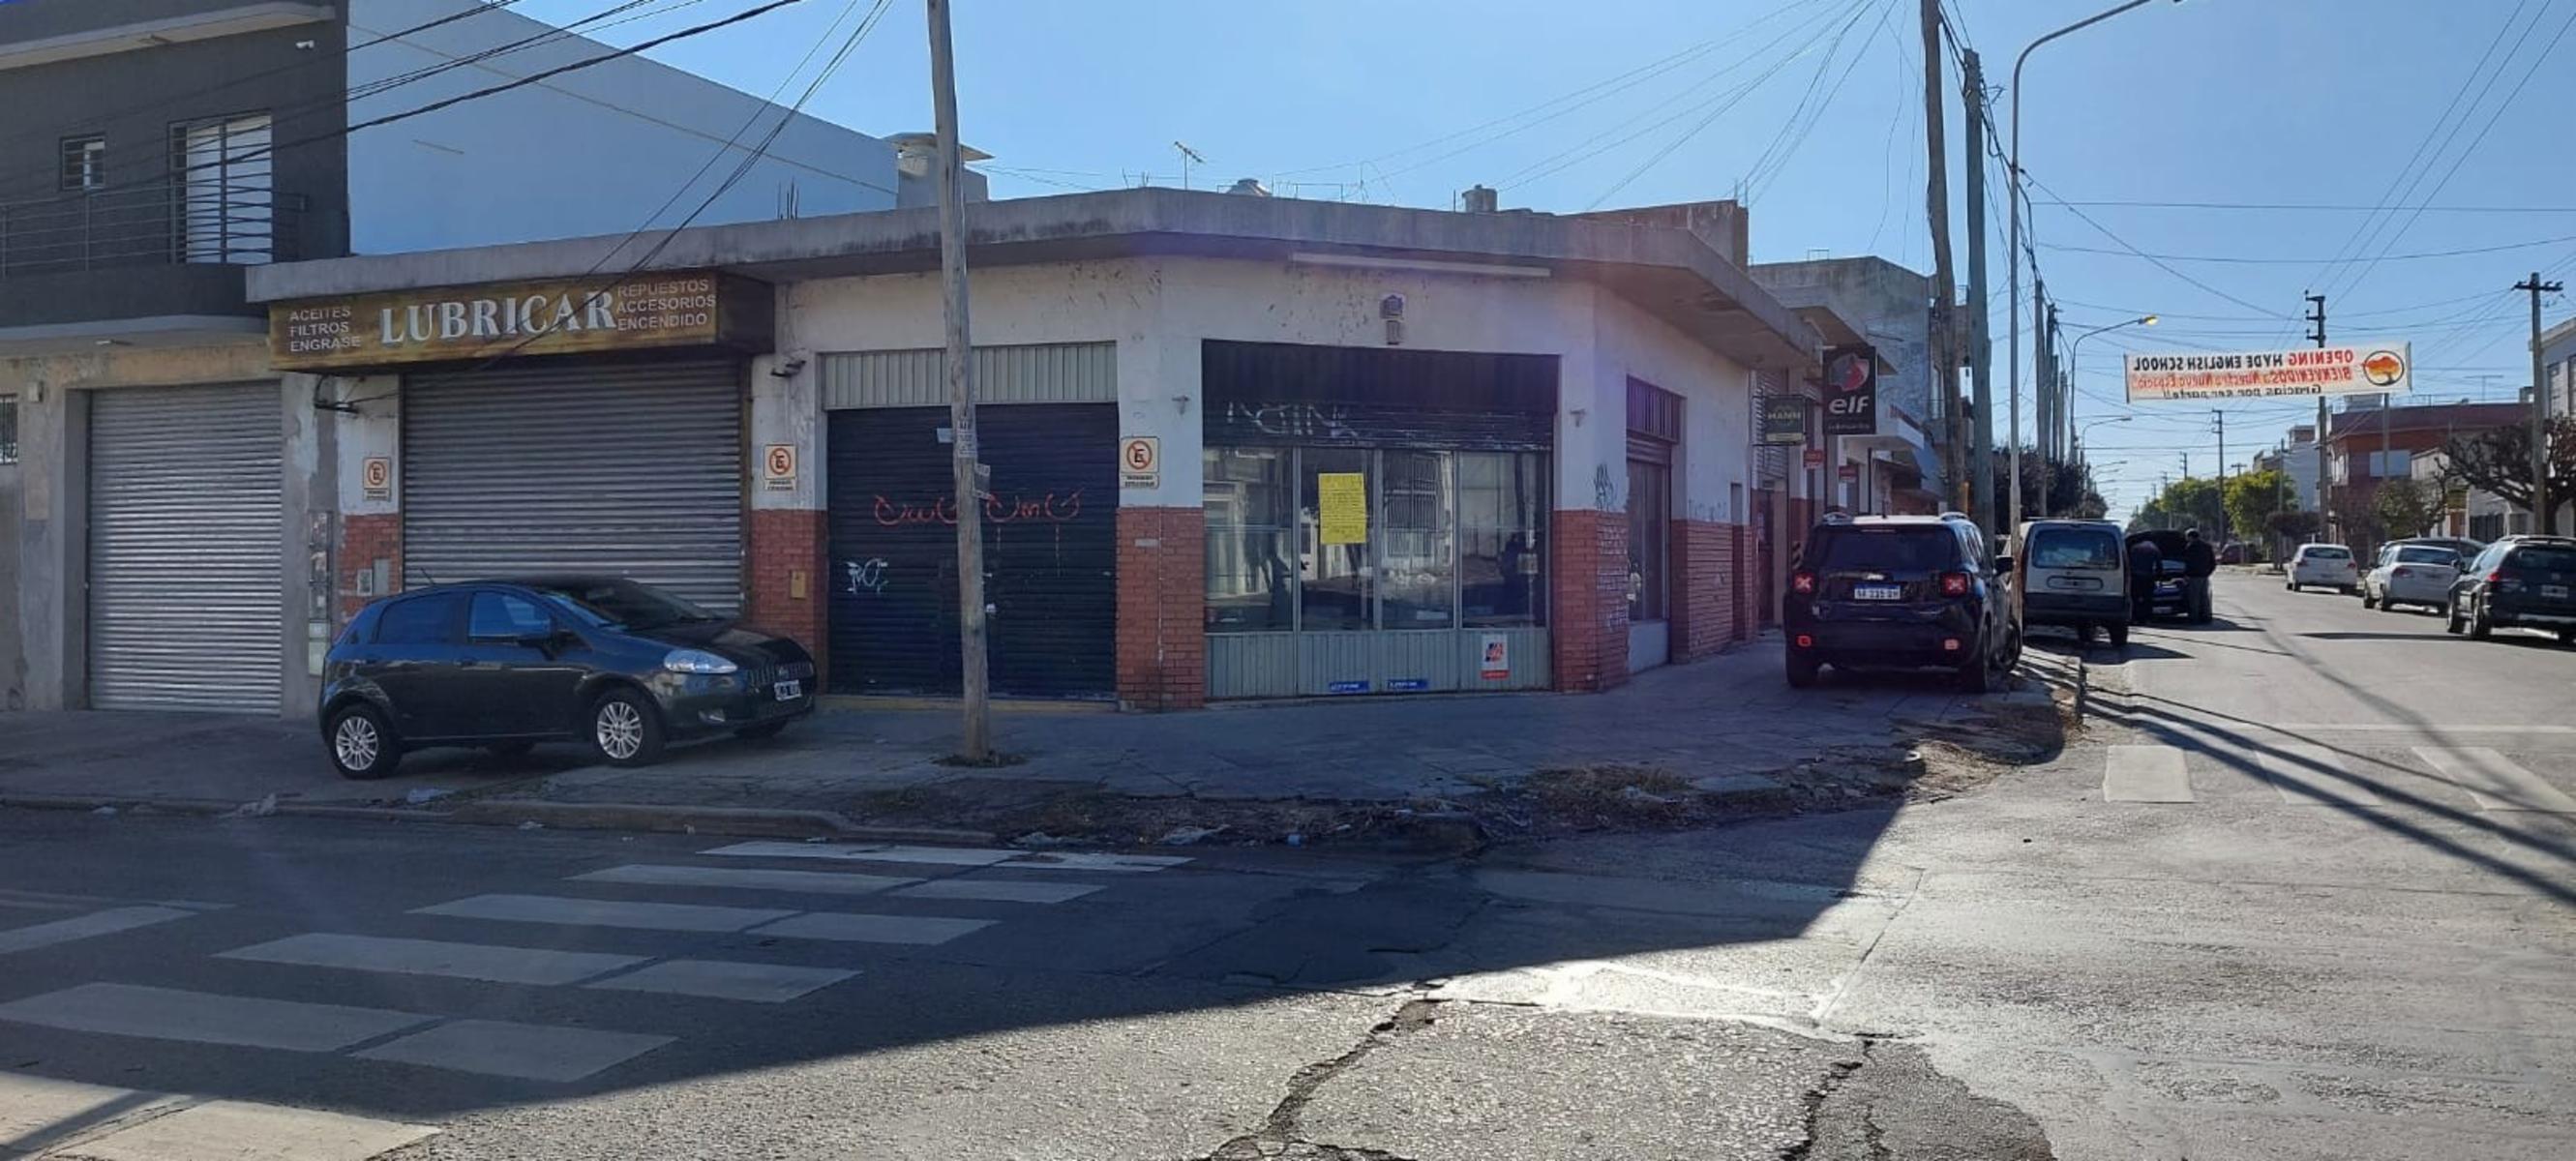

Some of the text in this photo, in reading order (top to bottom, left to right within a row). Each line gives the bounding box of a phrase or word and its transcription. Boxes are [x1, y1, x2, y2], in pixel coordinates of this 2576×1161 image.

[617, 279, 709, 297] REPUESTOS
[616, 293, 716, 313] ACCESORIOS
[289, 306, 351, 321] ACEITES
[380, 290, 616, 344] LUBRICAR
[617, 313, 708, 331] ENCENDIDO
[289, 320, 349, 337] FILTROS
[289, 335, 362, 352] ENGRASE
[1829, 396, 1869, 414] elf
